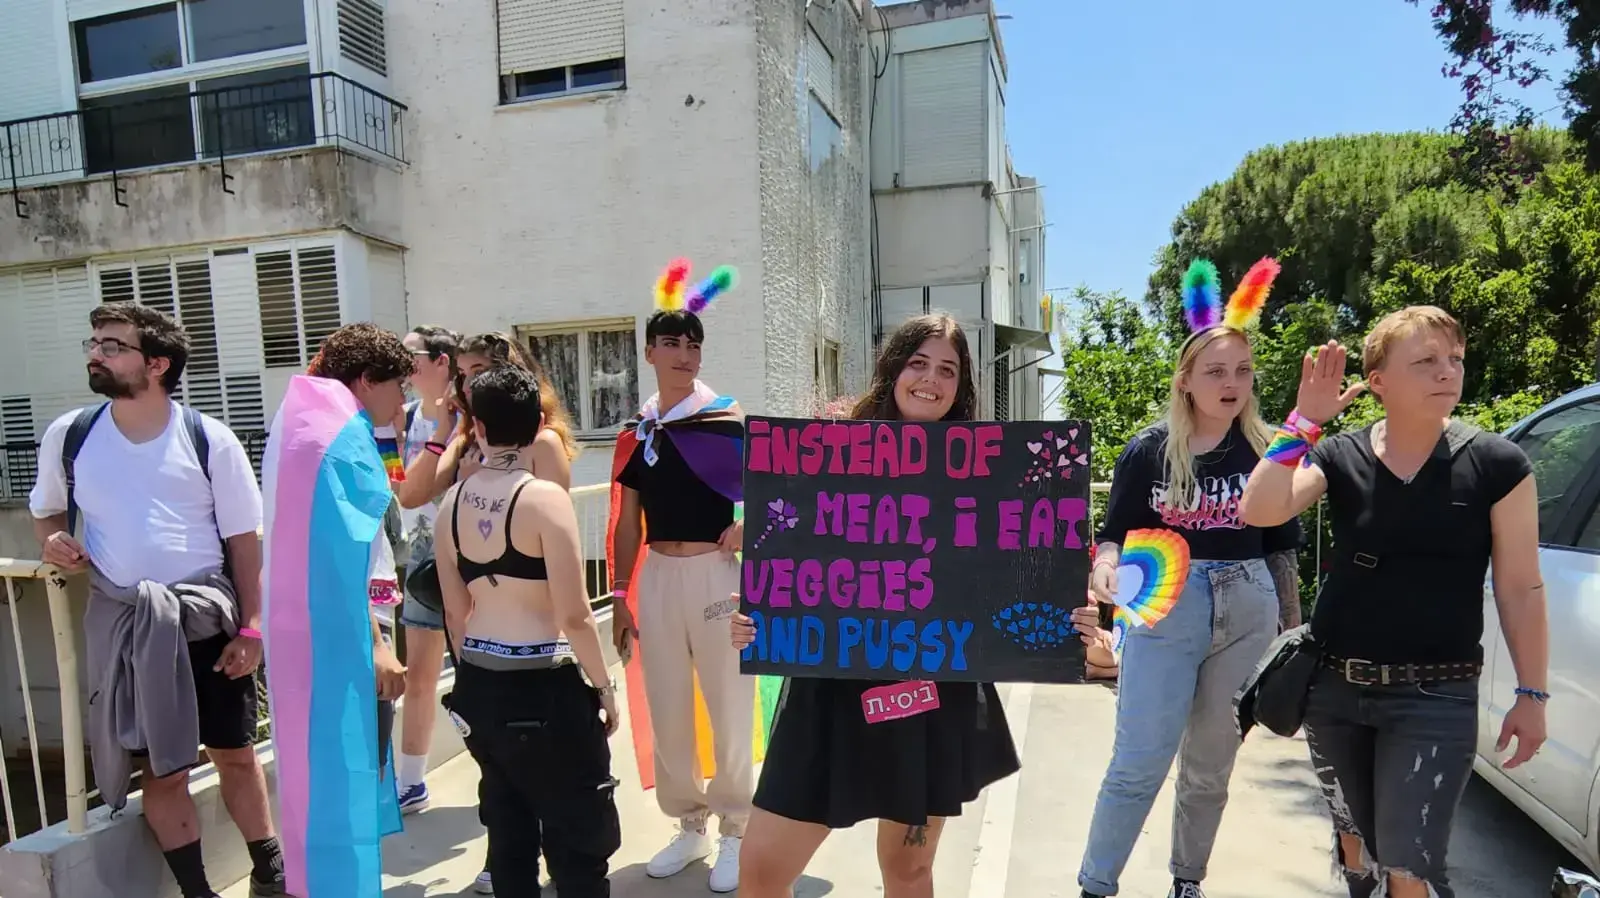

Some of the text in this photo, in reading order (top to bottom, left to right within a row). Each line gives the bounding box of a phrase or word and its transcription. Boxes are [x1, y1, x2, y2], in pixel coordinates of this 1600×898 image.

[946, 425, 1003, 479] OF
[814, 491, 936, 553] MEAT,
[998, 498, 1087, 549] EAT
[477, 641, 512, 655] umbro
[742, 610, 826, 665] AND
[837, 617, 974, 672] PUSSY
